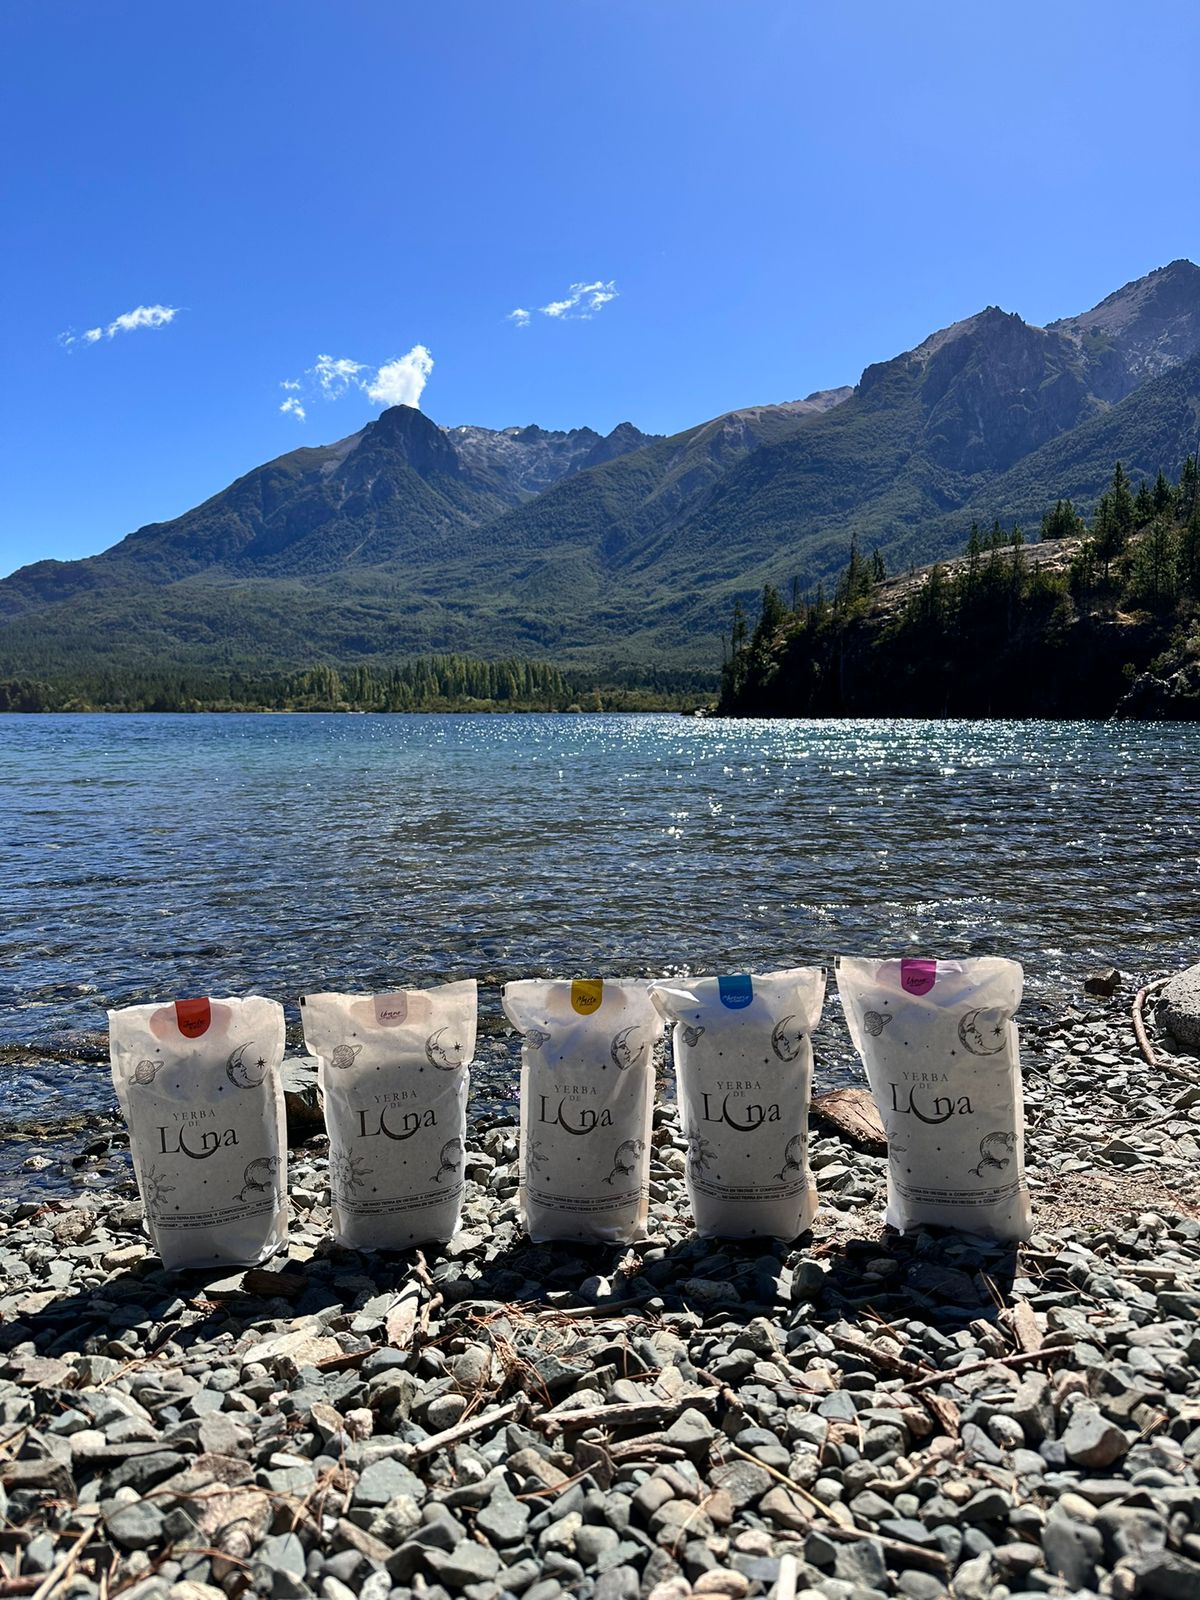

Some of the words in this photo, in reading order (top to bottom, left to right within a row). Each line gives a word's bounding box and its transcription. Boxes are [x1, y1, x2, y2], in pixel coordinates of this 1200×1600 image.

[902, 1071, 949, 1082] YERBA
[554, 1084, 598, 1095] YERBA
[716, 1080, 762, 1090] YERBA
[374, 1089, 418, 1104] YERBA
[172, 1108, 217, 1121] YERBA
